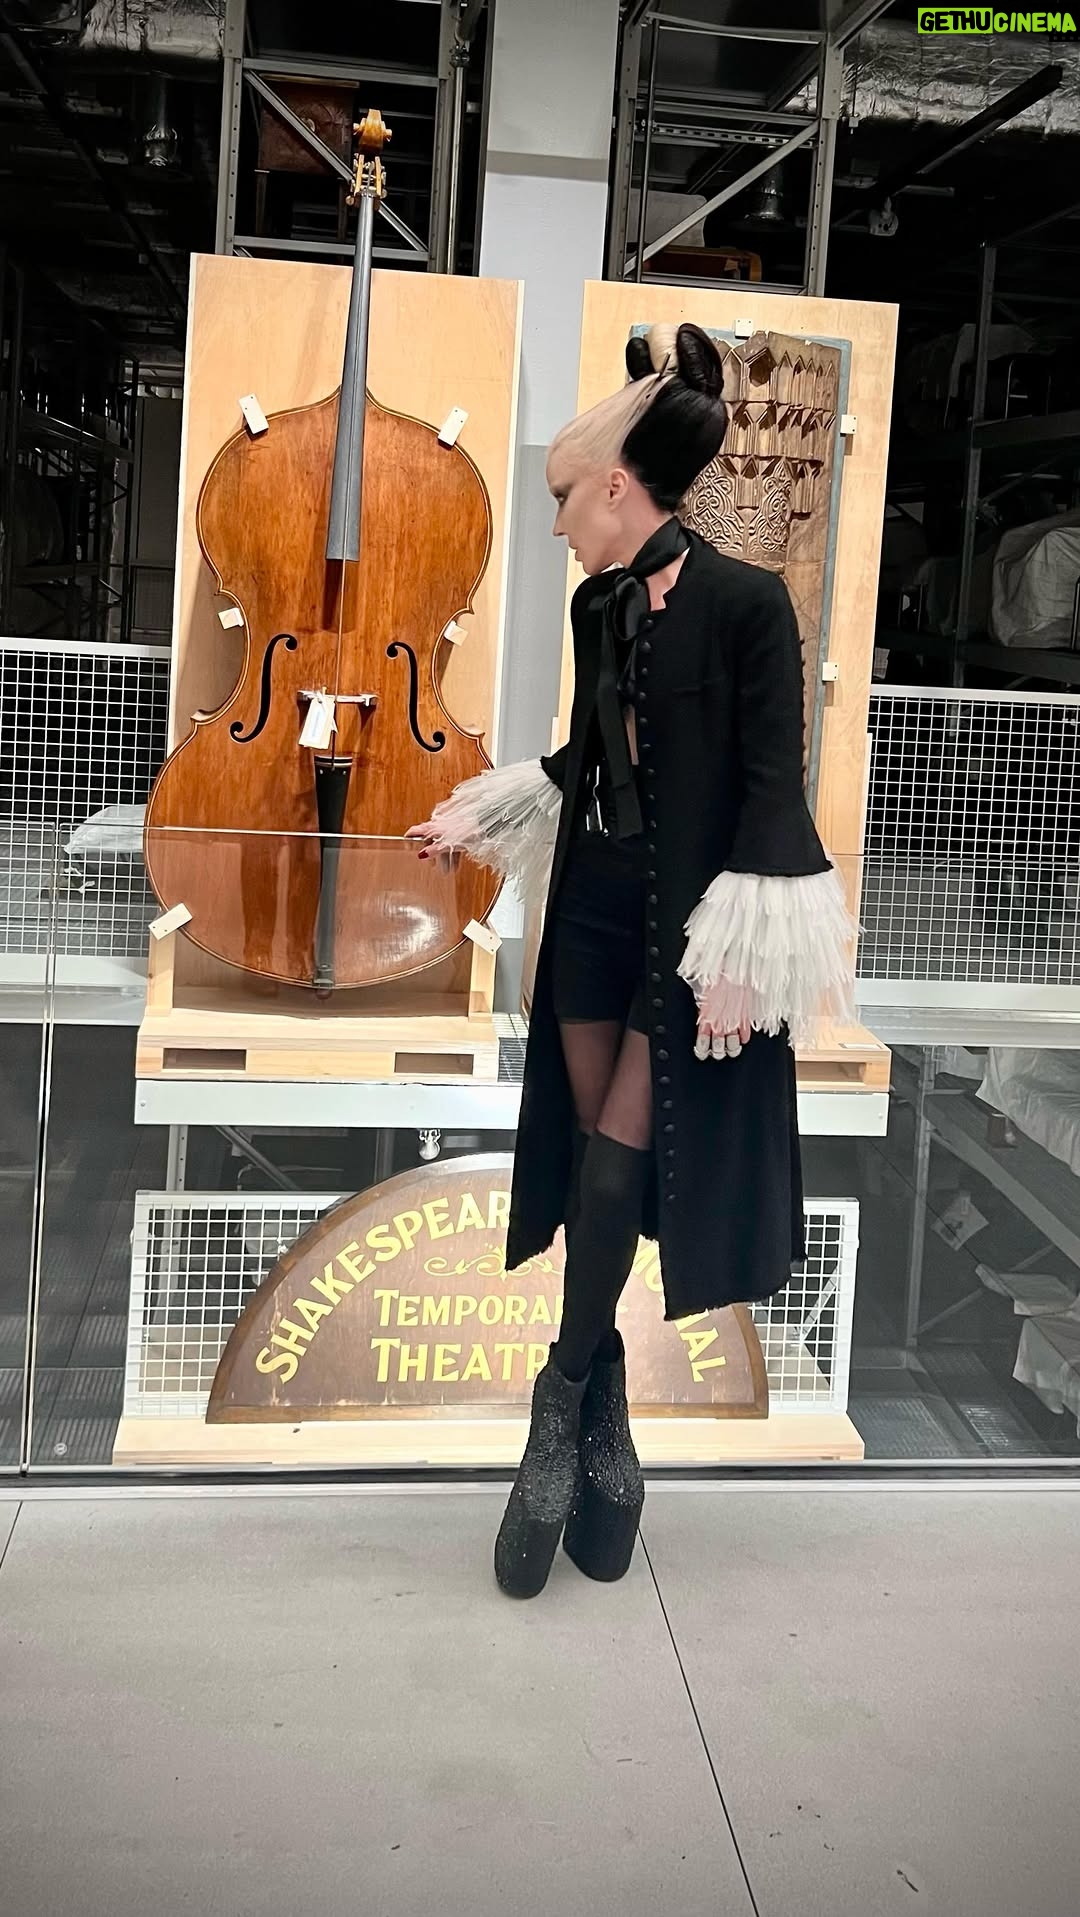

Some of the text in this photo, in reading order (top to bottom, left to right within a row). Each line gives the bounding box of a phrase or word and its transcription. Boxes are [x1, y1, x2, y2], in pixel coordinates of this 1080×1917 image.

[255, 1190, 512, 1384] SHAKESPEAR
[373, 1289, 565, 1326] TEMPORA
[371, 1337, 550, 1383] THEATR
